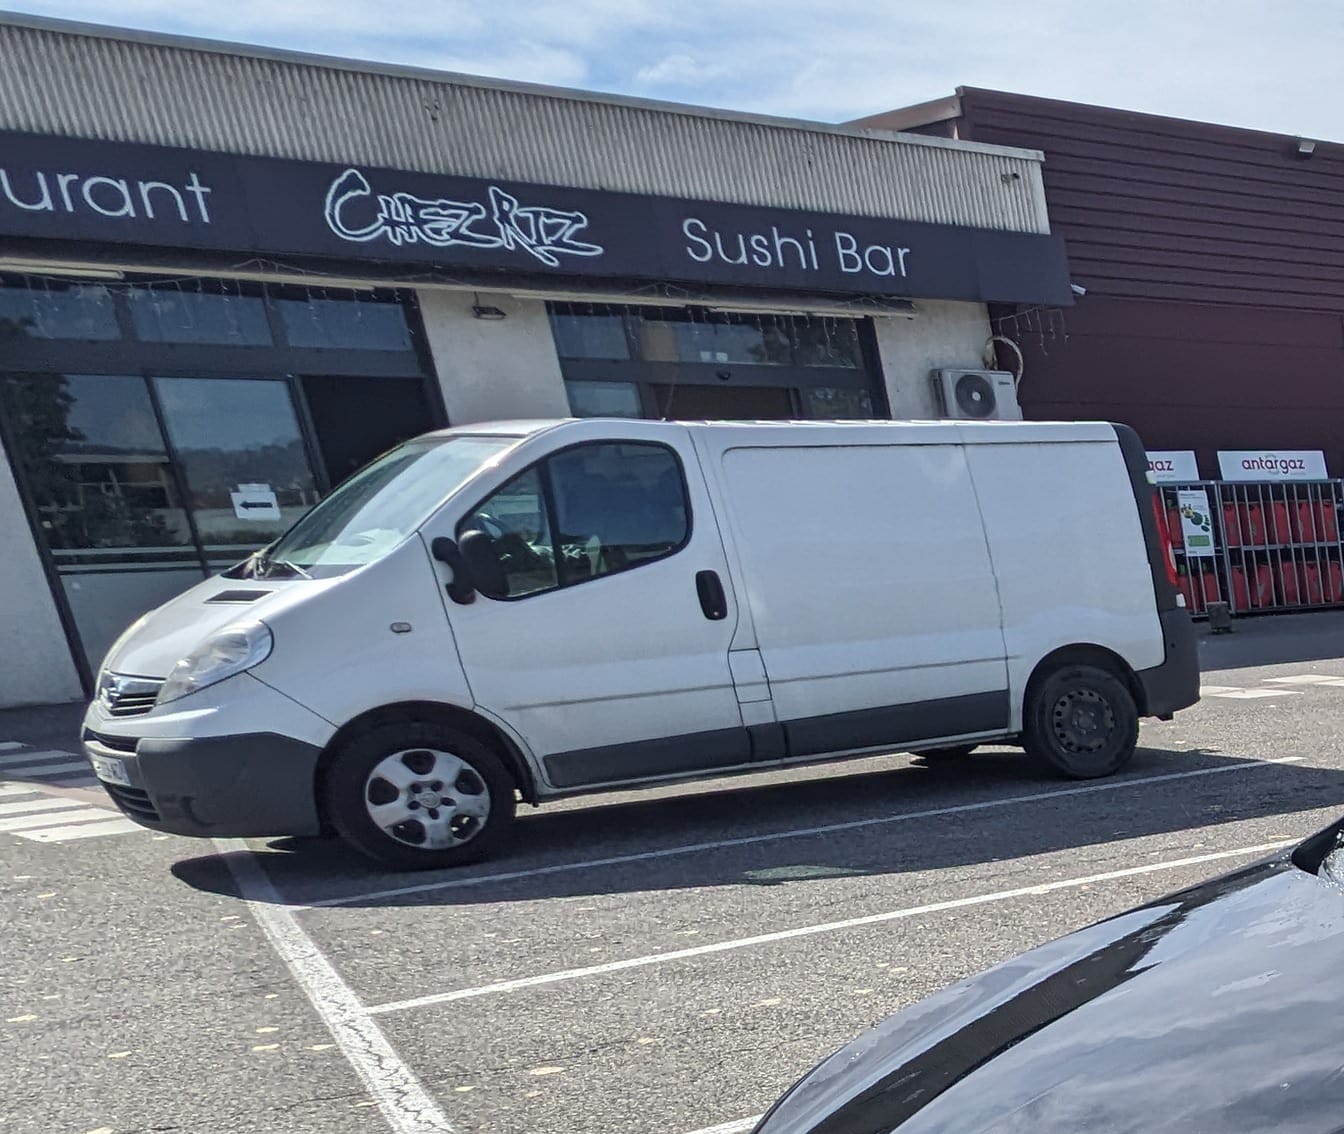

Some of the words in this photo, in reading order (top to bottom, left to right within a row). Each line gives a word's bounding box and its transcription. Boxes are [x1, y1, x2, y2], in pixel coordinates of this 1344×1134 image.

[0, 168, 212, 223] urant
[682, 217, 819, 270] Sushi
[834, 231, 911, 278] Bar
[1241, 456, 1306, 475] antargaz
